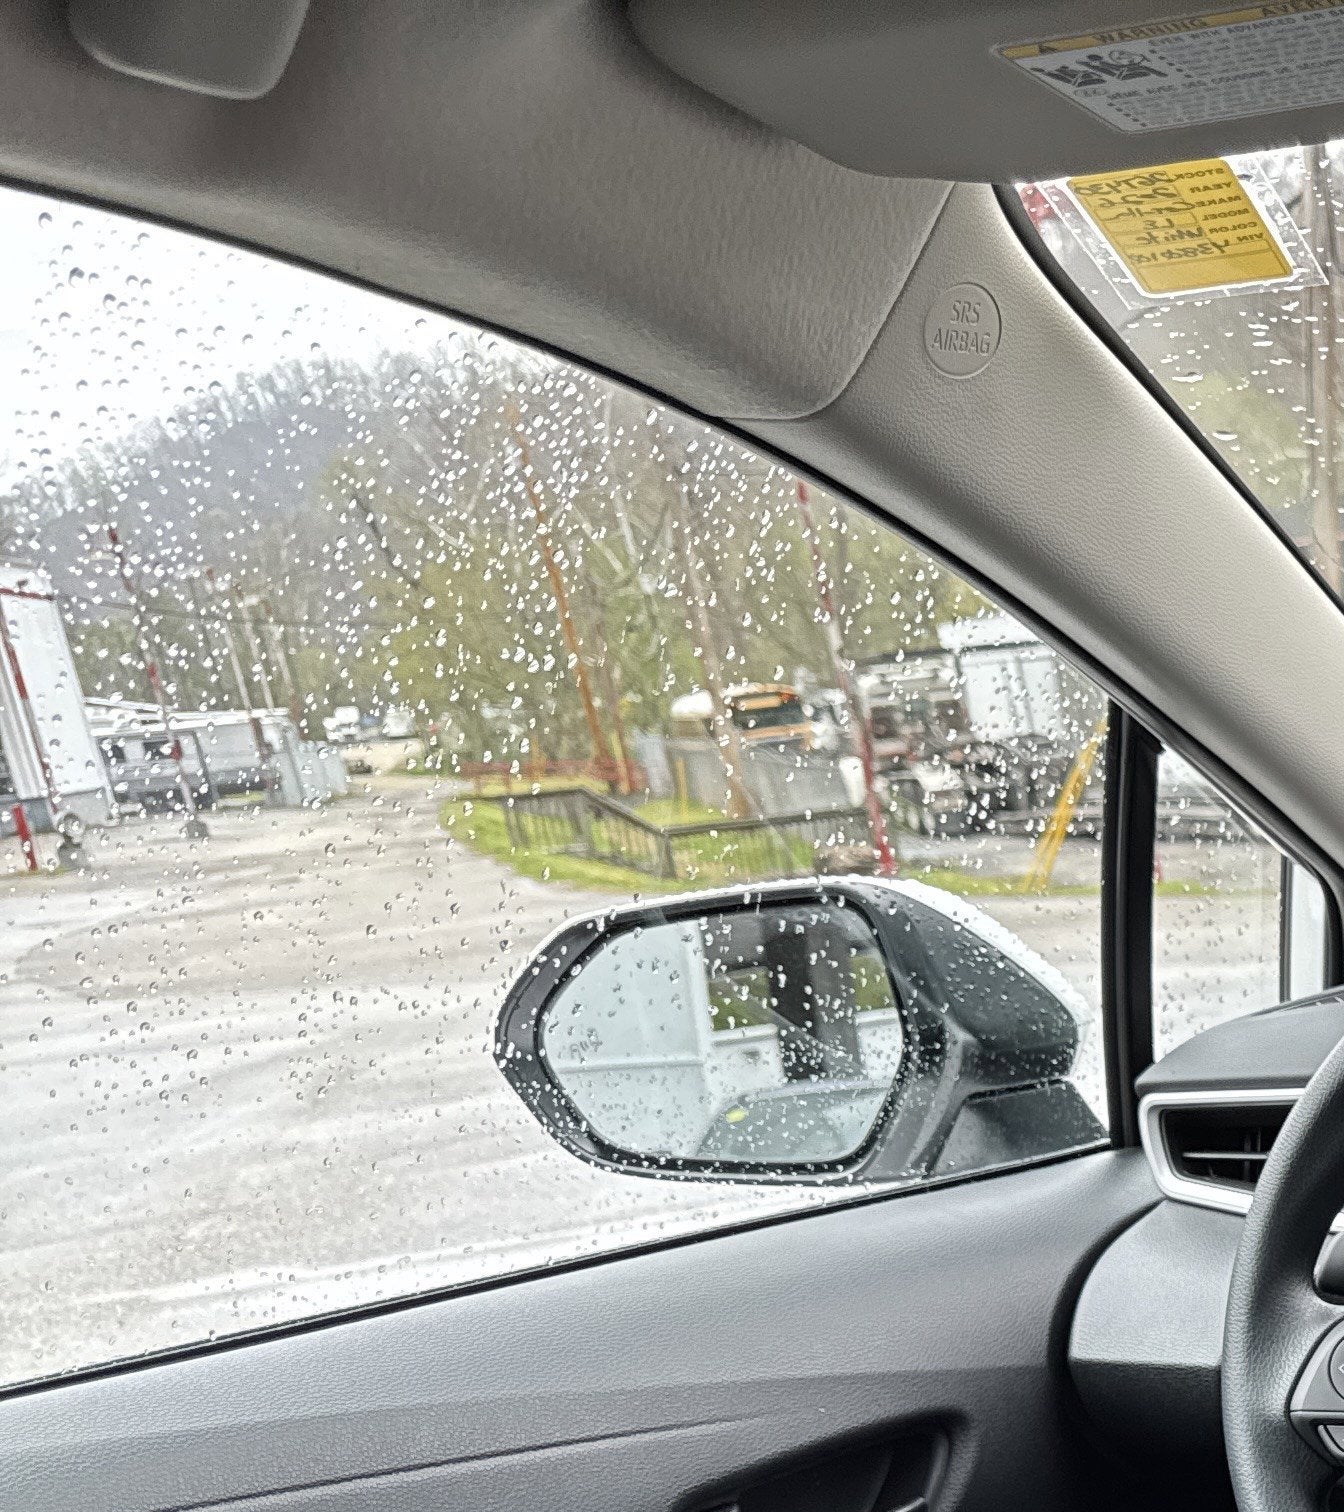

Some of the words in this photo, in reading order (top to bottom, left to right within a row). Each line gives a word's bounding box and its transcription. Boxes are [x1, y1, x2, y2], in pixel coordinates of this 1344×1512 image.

[1097, 18, 1209, 44] WARNING
[950, 300, 981, 326] SRS
[931, 328, 991, 356] AIRBAG
